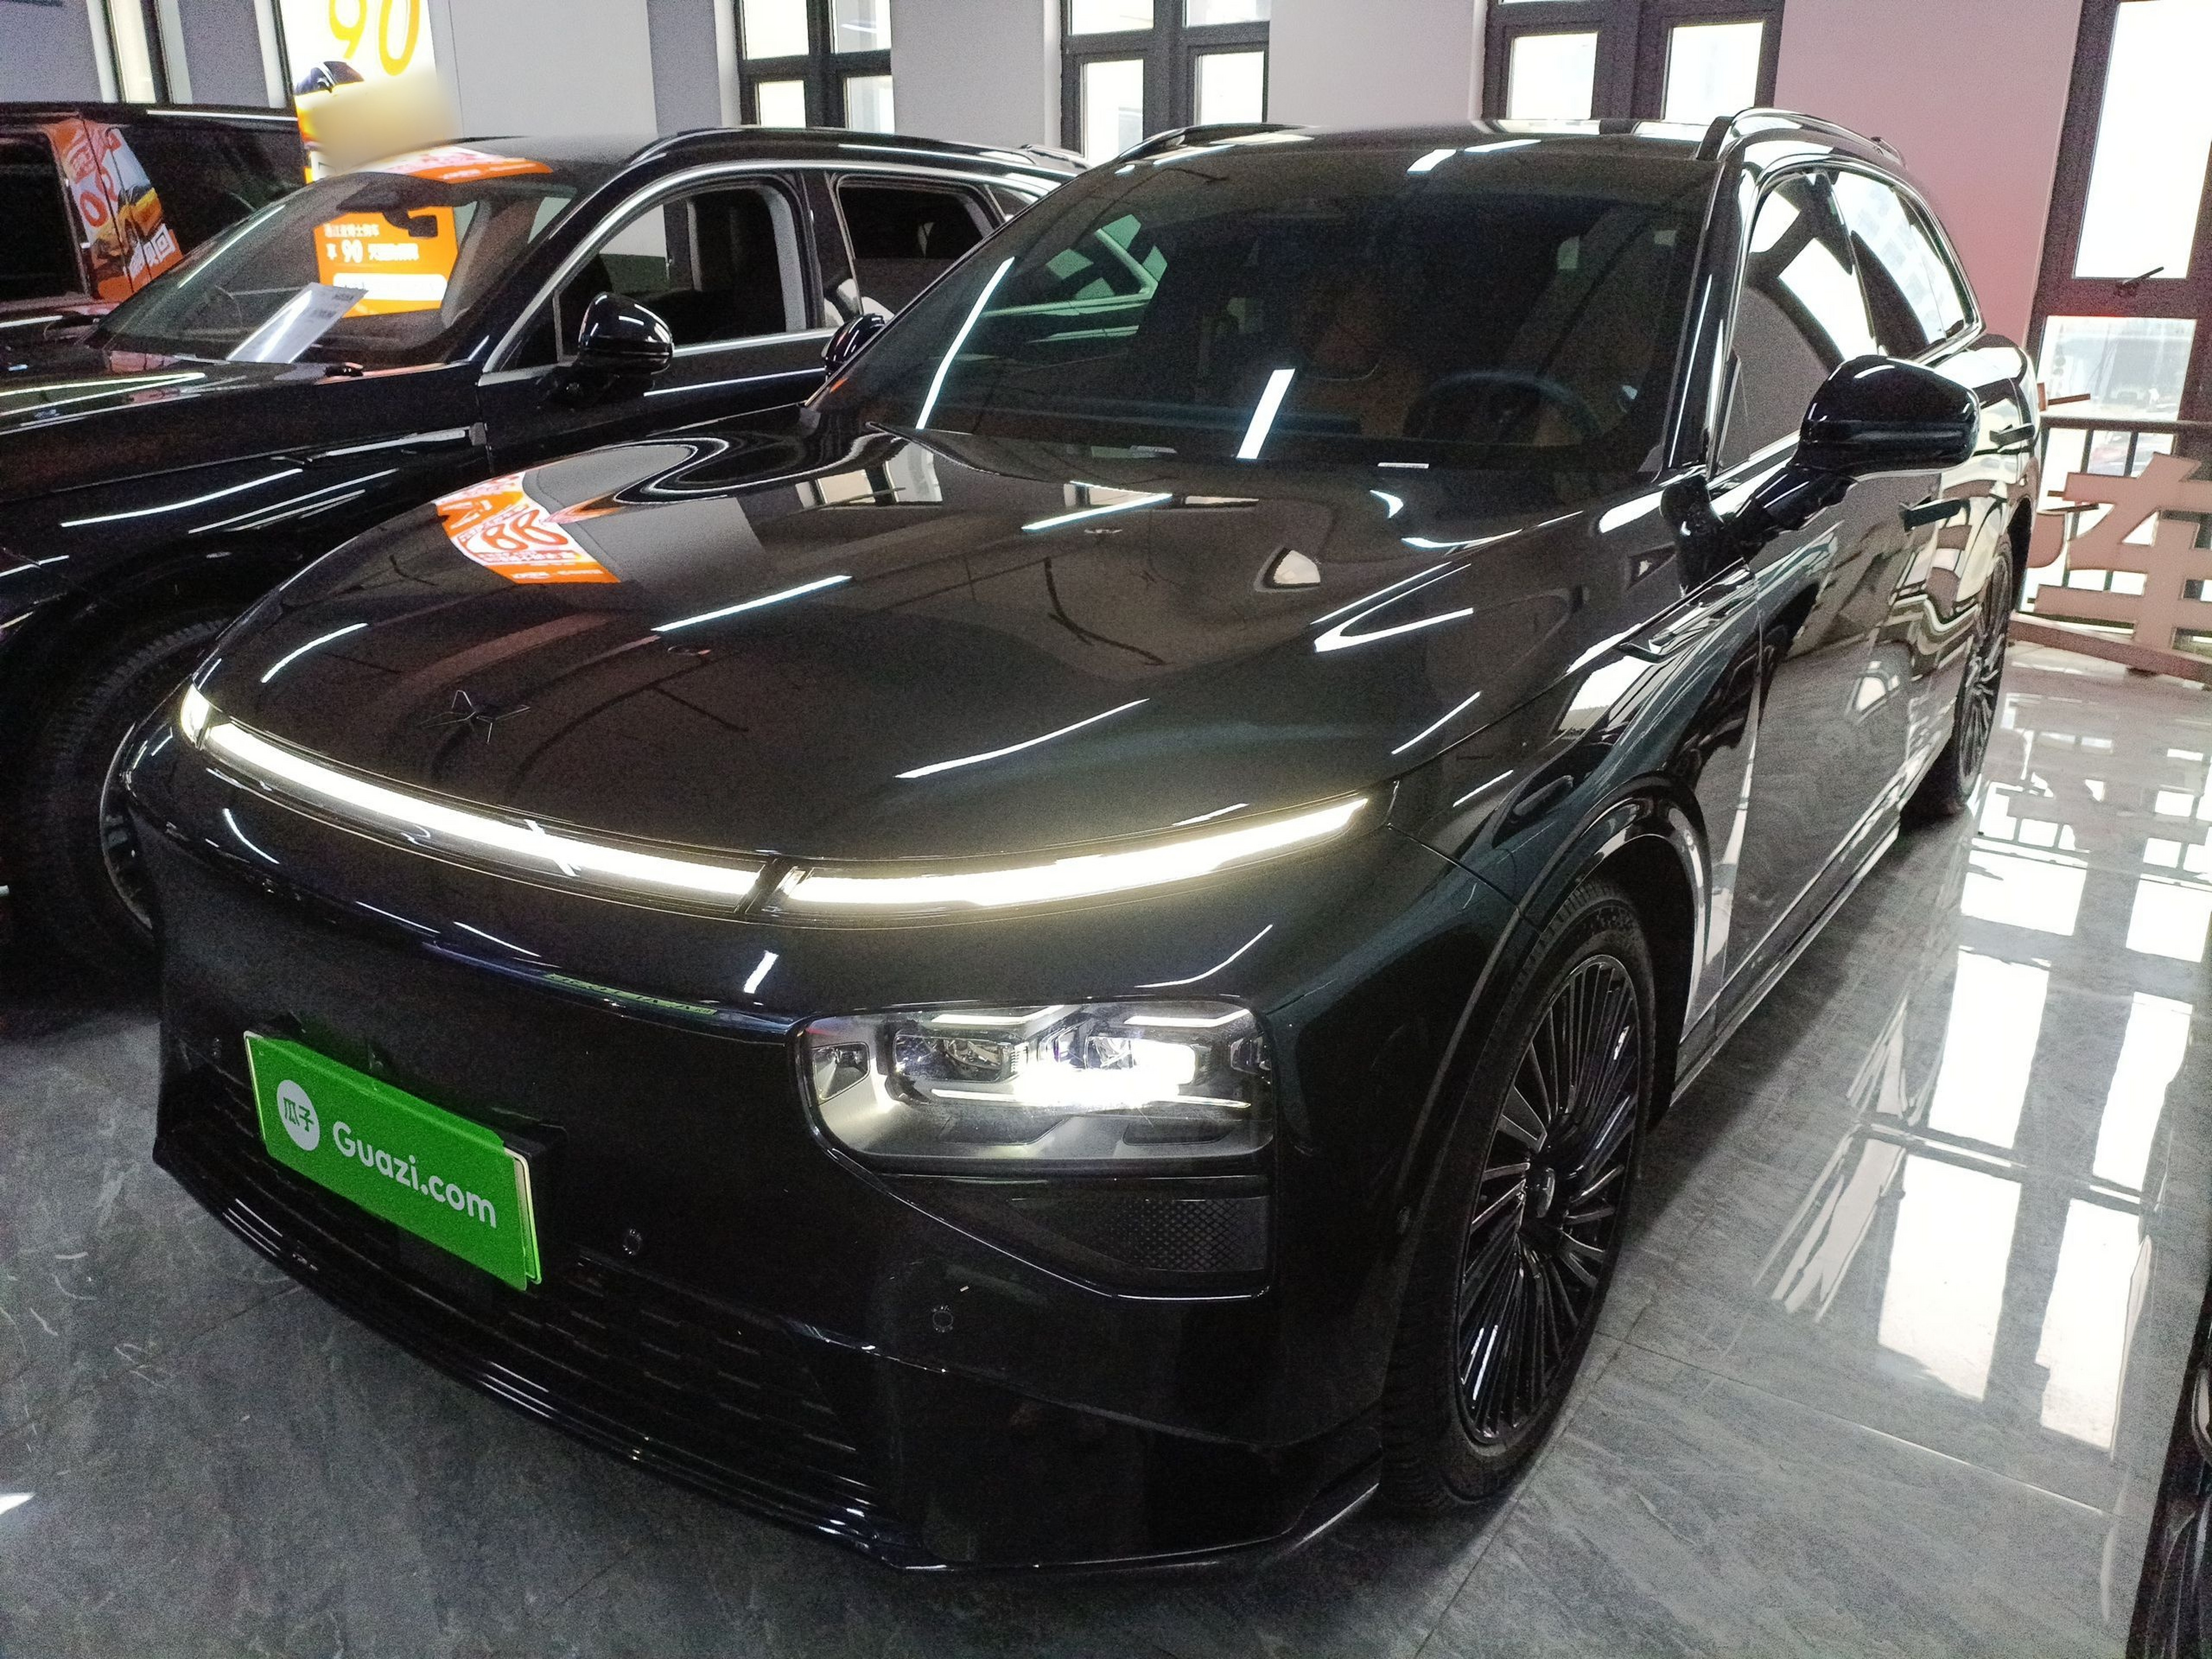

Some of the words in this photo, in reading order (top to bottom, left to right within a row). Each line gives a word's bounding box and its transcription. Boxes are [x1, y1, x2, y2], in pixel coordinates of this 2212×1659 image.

[329, 0, 421, 76] 90
[341, 239, 363, 263] 90
[283, 1096, 315, 1132] 瓜子
[333, 1121, 497, 1228] Guazi.com
